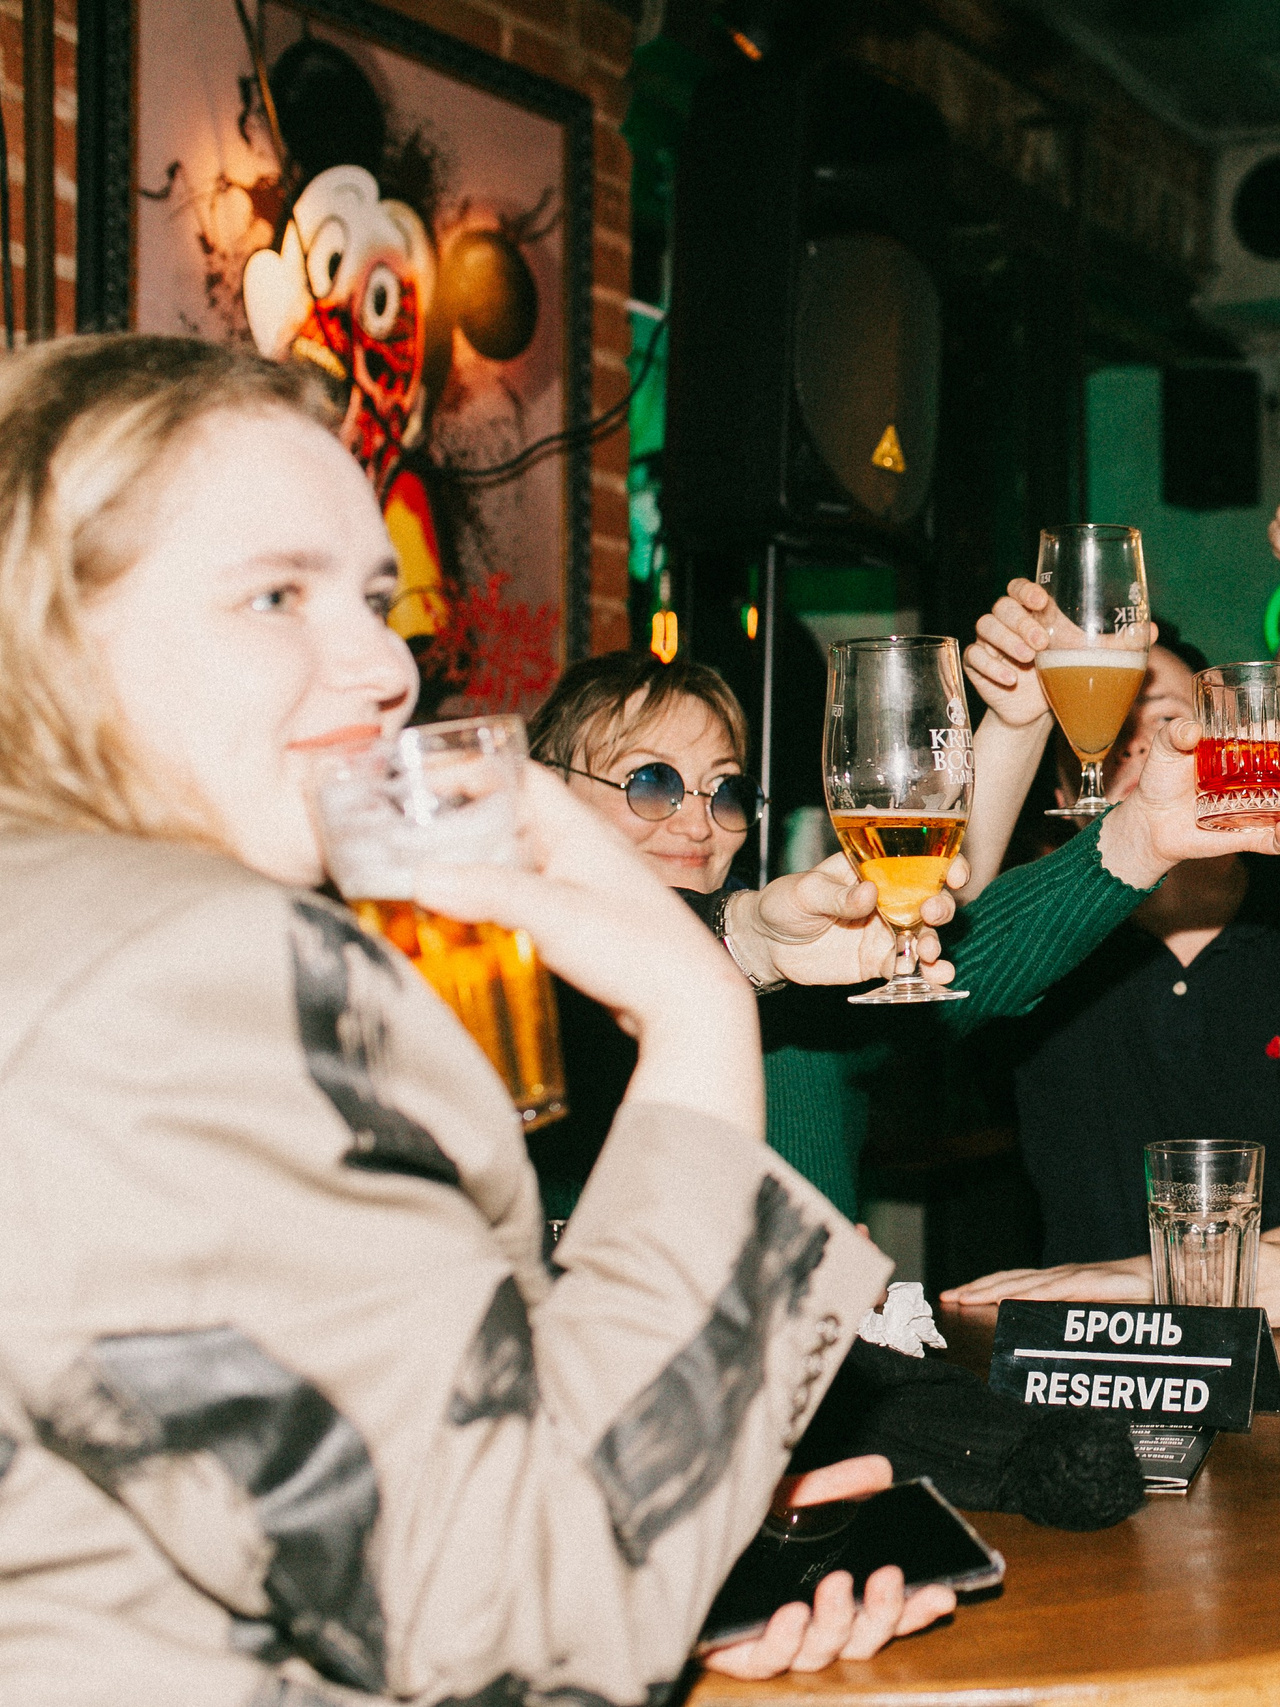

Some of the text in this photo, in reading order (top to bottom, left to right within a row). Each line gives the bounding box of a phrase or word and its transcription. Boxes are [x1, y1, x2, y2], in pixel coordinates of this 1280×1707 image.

[929, 728, 973, 749] KRIE
[931, 749, 975, 771] BOO
[1064, 1309, 1183, 1346] БРОНЬ
[1024, 1371, 1210, 1413] RESERVED
